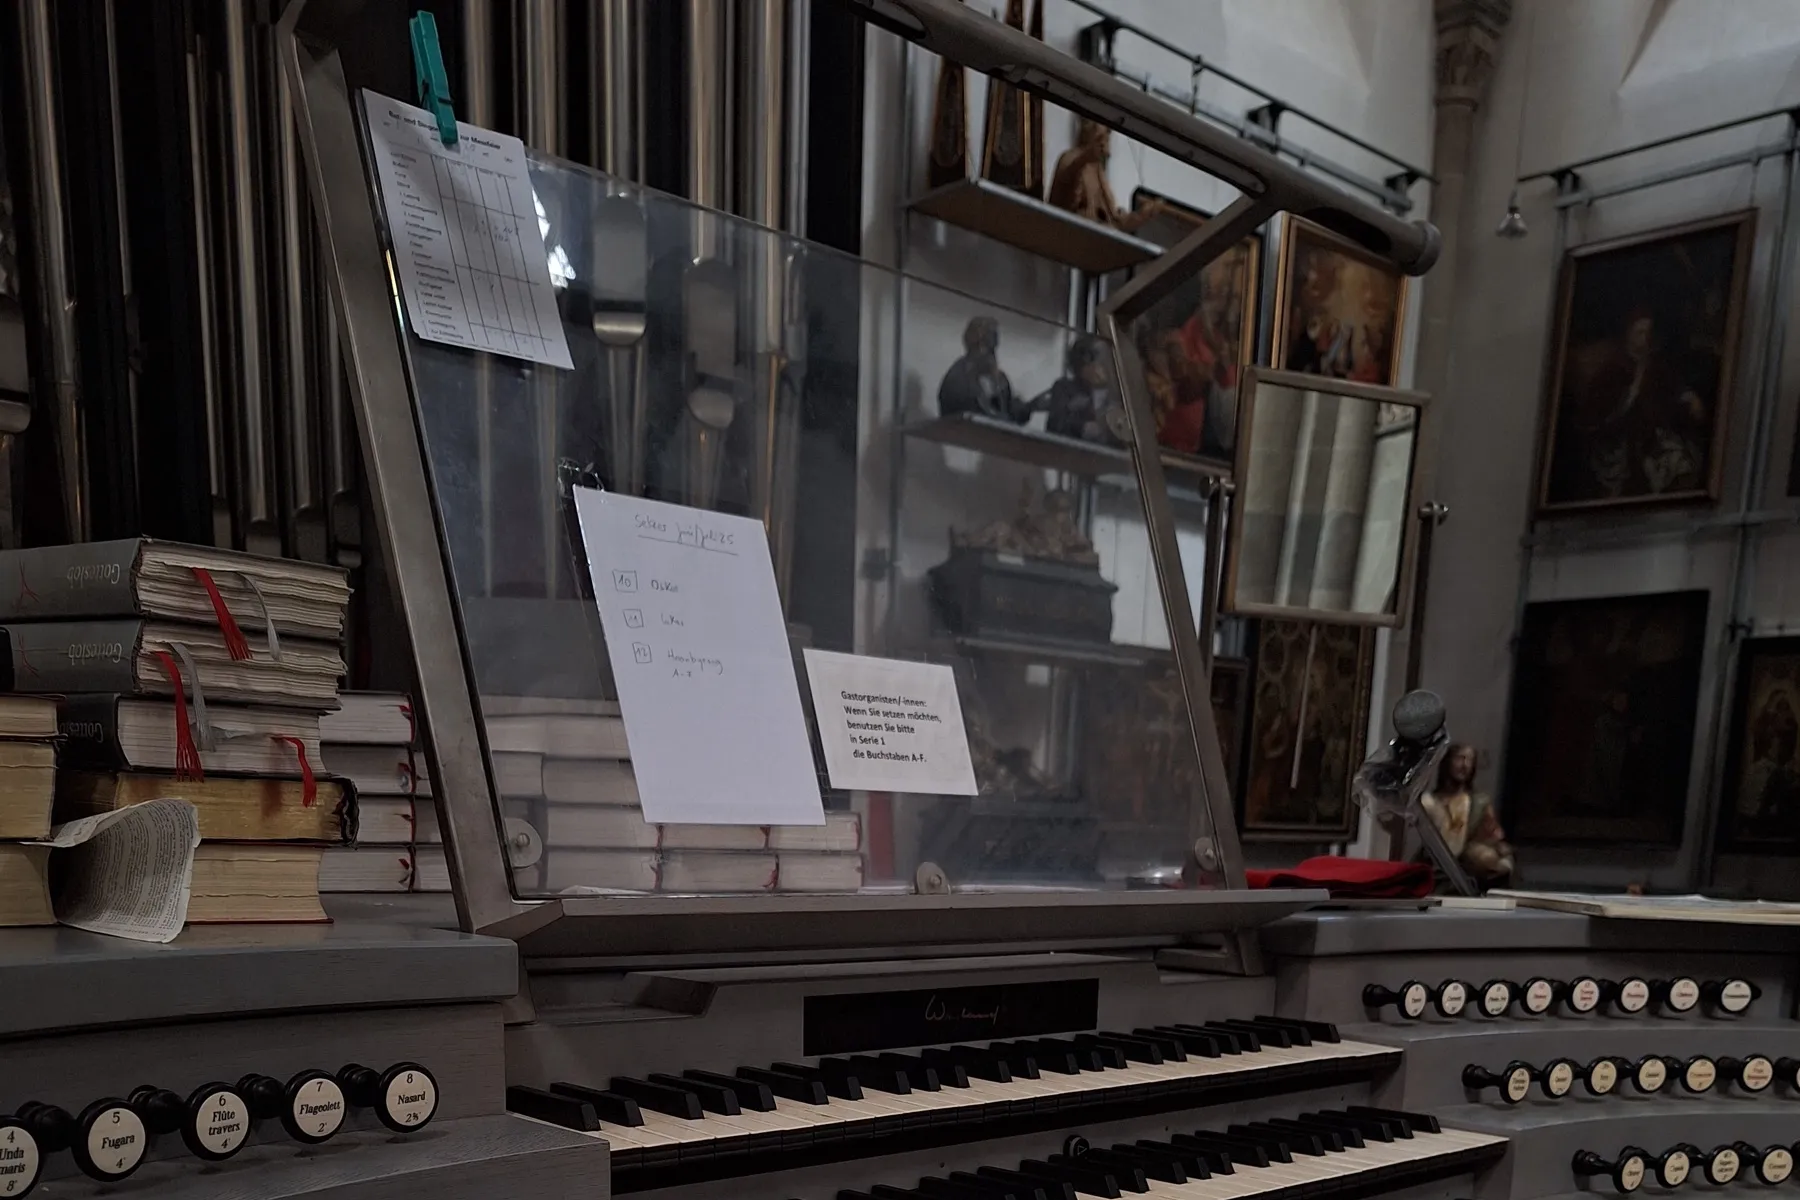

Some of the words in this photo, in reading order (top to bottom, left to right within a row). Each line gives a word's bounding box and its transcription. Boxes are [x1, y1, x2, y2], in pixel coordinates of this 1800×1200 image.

[67, 563, 121, 589] Gotteslob
[618, 574, 632, 588] 10
[68, 643, 123, 666] Gotteslob
[843, 705, 868, 716] Wenn
[868, 707, 881, 717] Sie
[882, 709, 906, 719] setzen
[907, 711, 942, 723] möchten,
[846, 719, 883, 732] benutzen
[884, 723, 896, 733] Sie
[896, 724, 915, 734] bitte
[849, 734, 858, 744] in
[859, 735, 879, 745] Serie
[853, 749, 865, 759] die
[866, 750, 910, 762] Buchstaben
[911, 753, 927, 763] A-F.
[406, 1073, 413, 1084] 8
[316, 1081, 323, 1093] 7
[218, 1095, 226, 1107] 6
[397, 1091, 426, 1105] Nasard
[299, 1101, 341, 1116] Flageolett
[112, 1111, 121, 1124] 5
[212, 1110, 236, 1123] Flûte
[208, 1123, 240, 1136] travers
[7, 1130, 15, 1143] 4
[101, 1134, 135, 1150] Fugara
[0, 1147, 25, 1160] Unda
